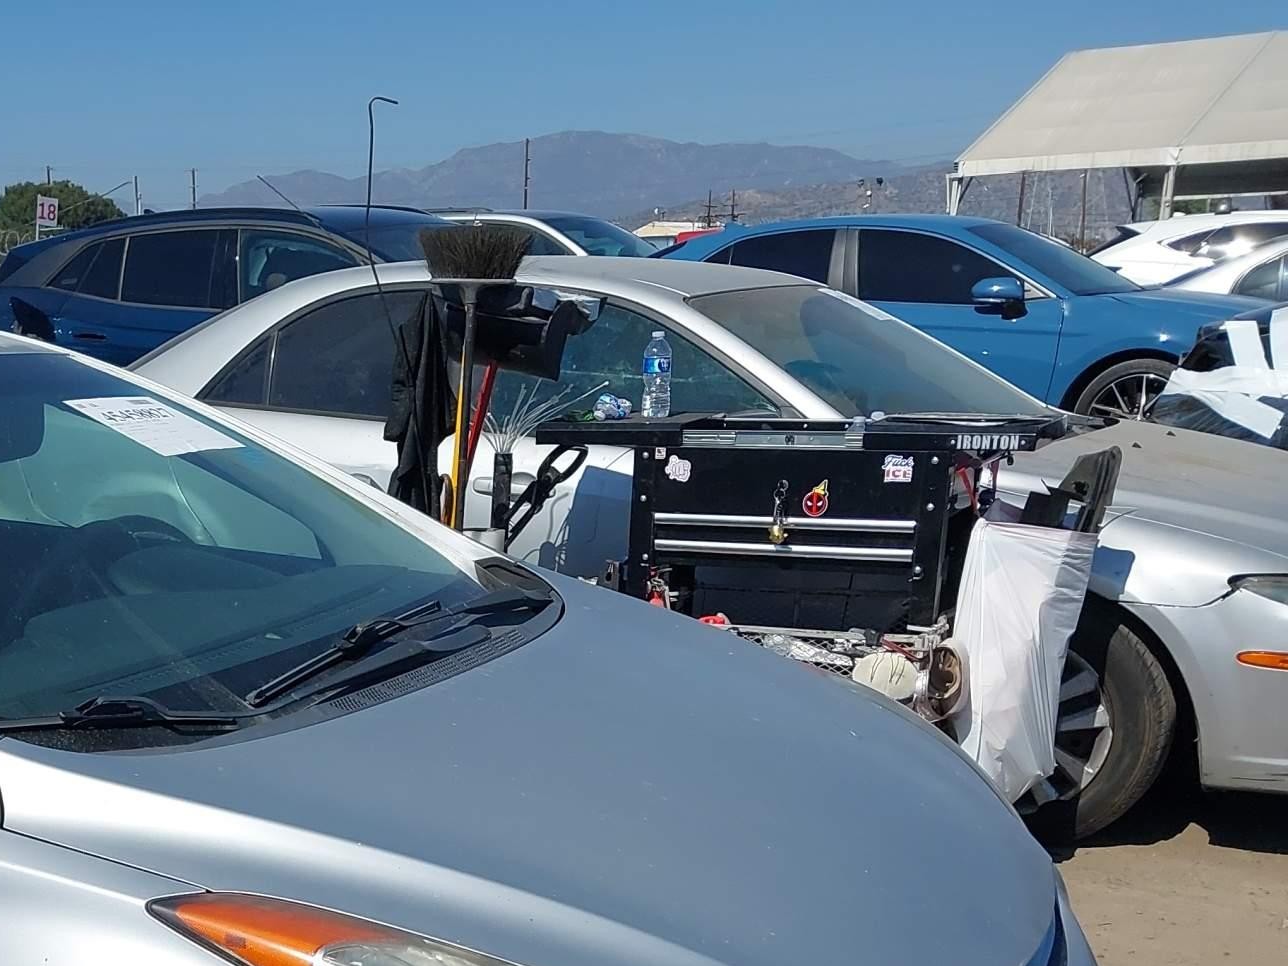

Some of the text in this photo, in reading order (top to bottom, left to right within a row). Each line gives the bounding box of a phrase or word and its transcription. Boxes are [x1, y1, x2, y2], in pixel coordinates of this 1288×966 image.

[38, 203, 56, 220] 18
[101, 407, 176, 422] 45458827
[956, 434, 1019, 450] IRONTON
[886, 469, 911, 479] ICE
